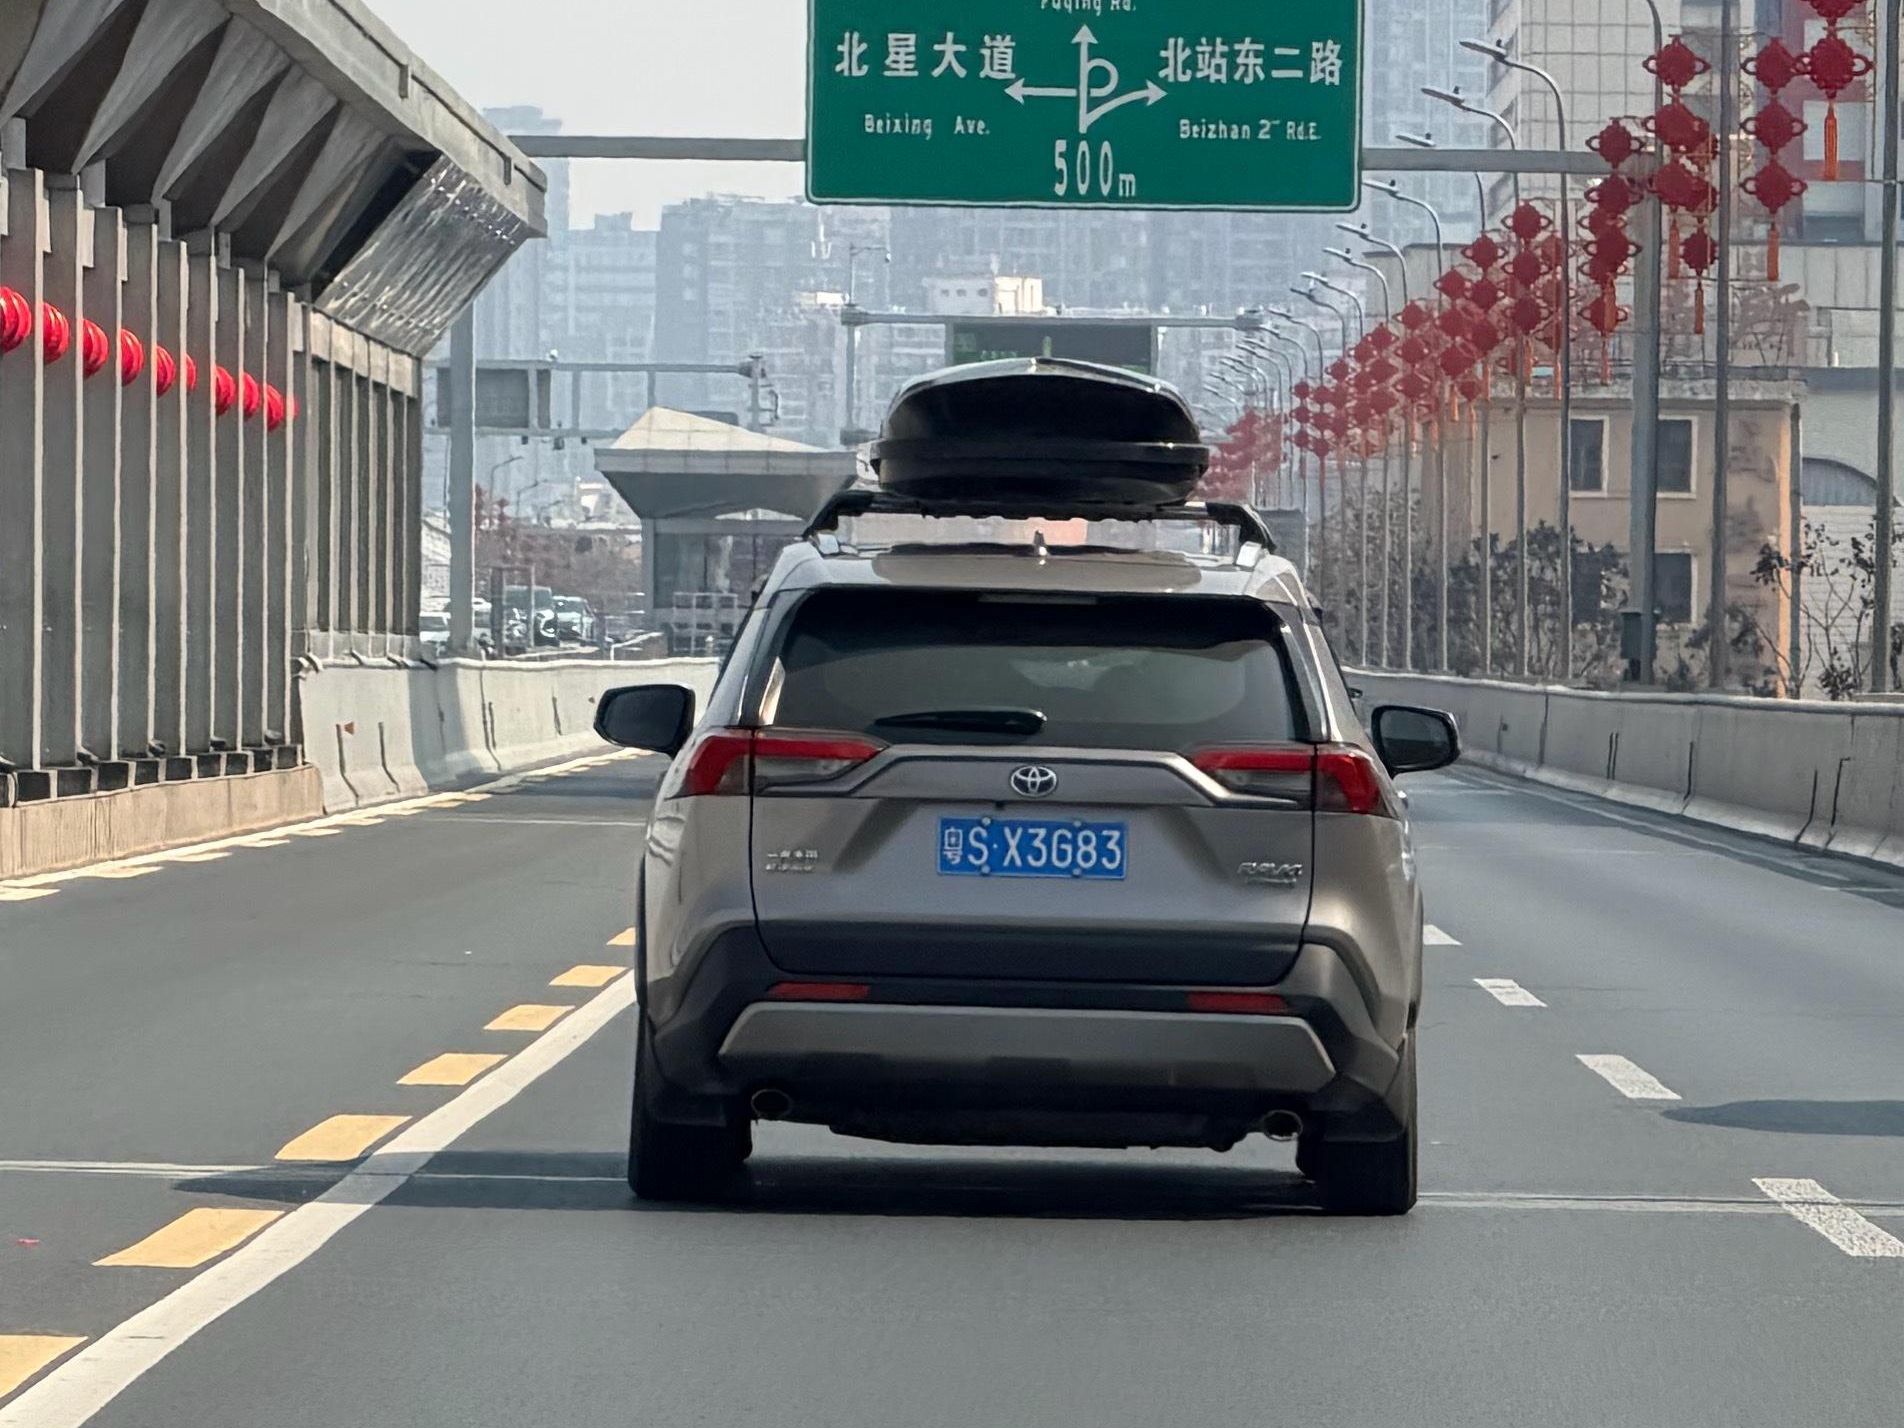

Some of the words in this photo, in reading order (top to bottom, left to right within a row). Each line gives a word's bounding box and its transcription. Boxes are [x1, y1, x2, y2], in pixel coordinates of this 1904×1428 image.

[835, 31, 1016, 80] 北星大道
[1159, 36, 1343, 85] 北站东二路
[864, 113, 932, 140] Beixing
[954, 115, 990, 135] Ave.
[1179, 118, 1250, 139] Beizhan
